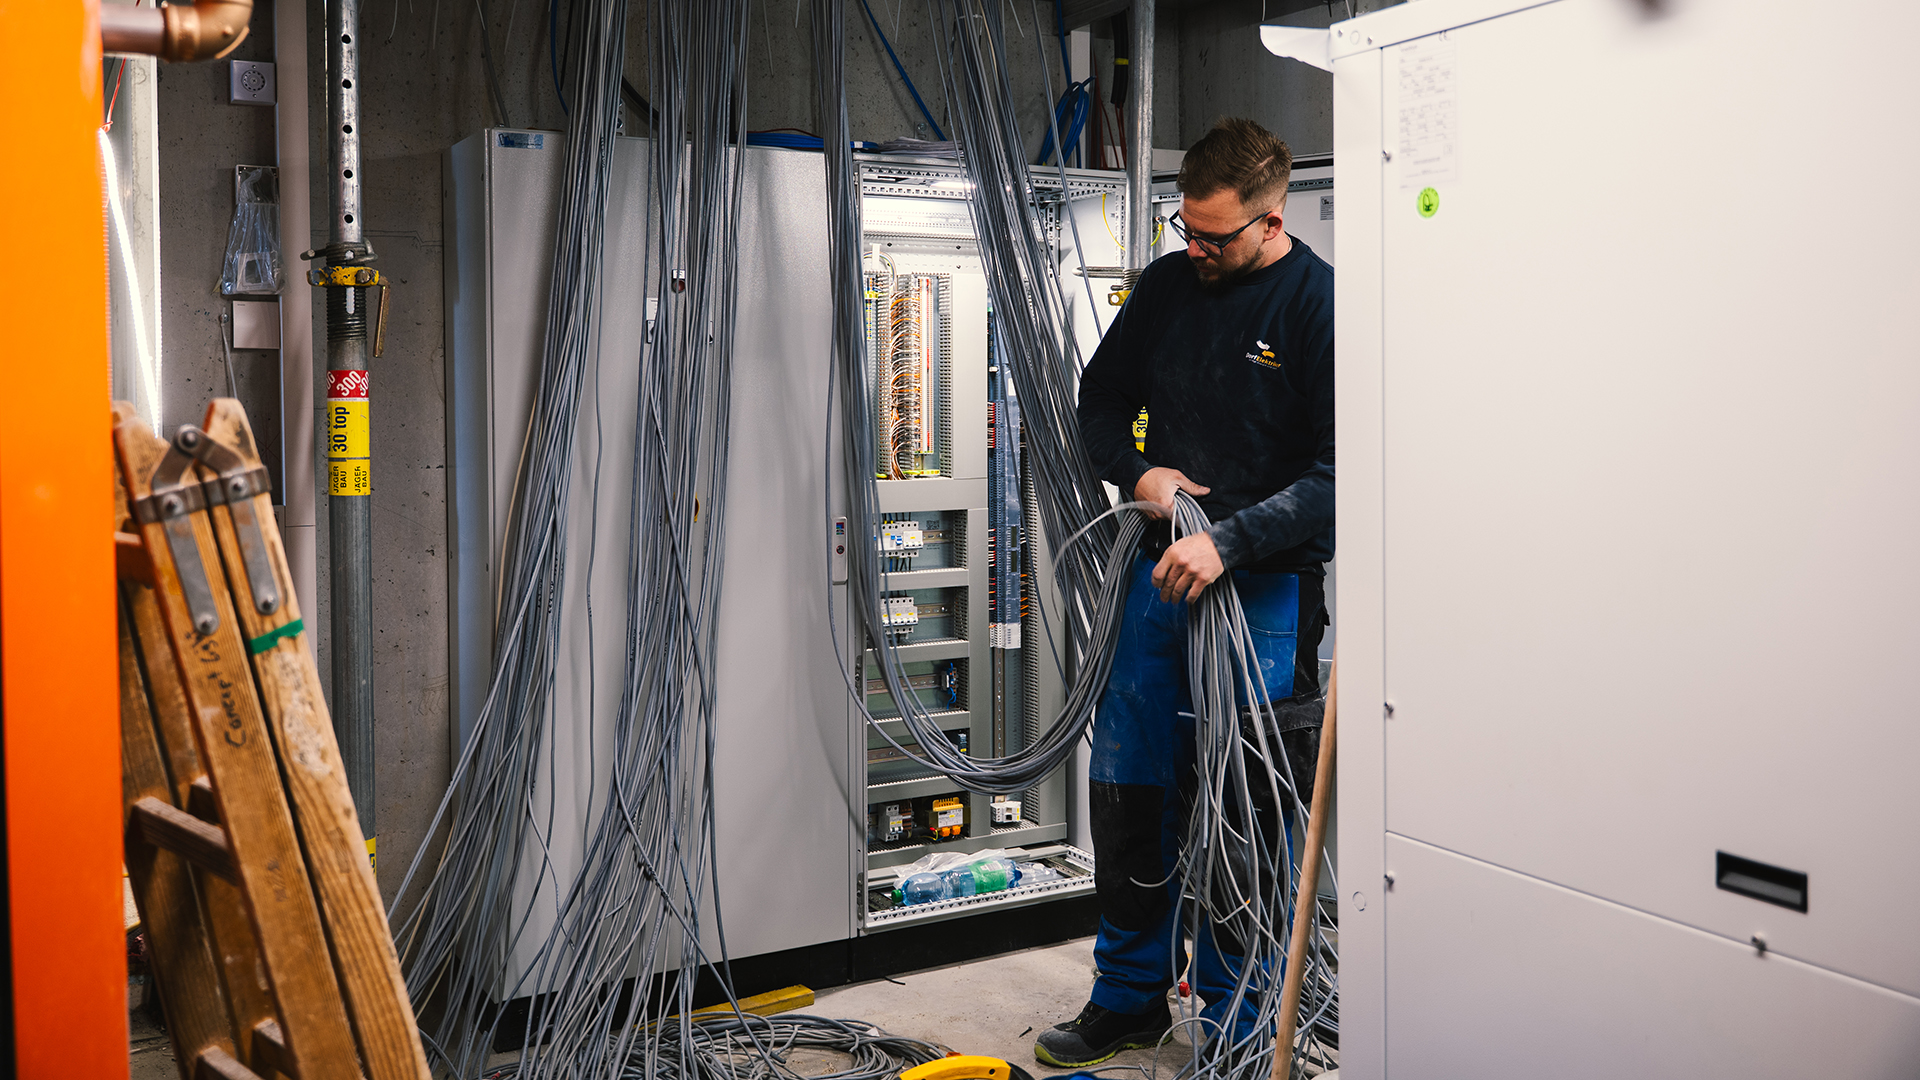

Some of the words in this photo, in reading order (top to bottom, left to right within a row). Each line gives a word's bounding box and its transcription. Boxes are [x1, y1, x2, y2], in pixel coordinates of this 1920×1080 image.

[336, 370, 361, 397] 300
[333, 406, 350, 429] top
[1136, 418, 1148, 433] 30
[333, 434, 347, 452] 30
